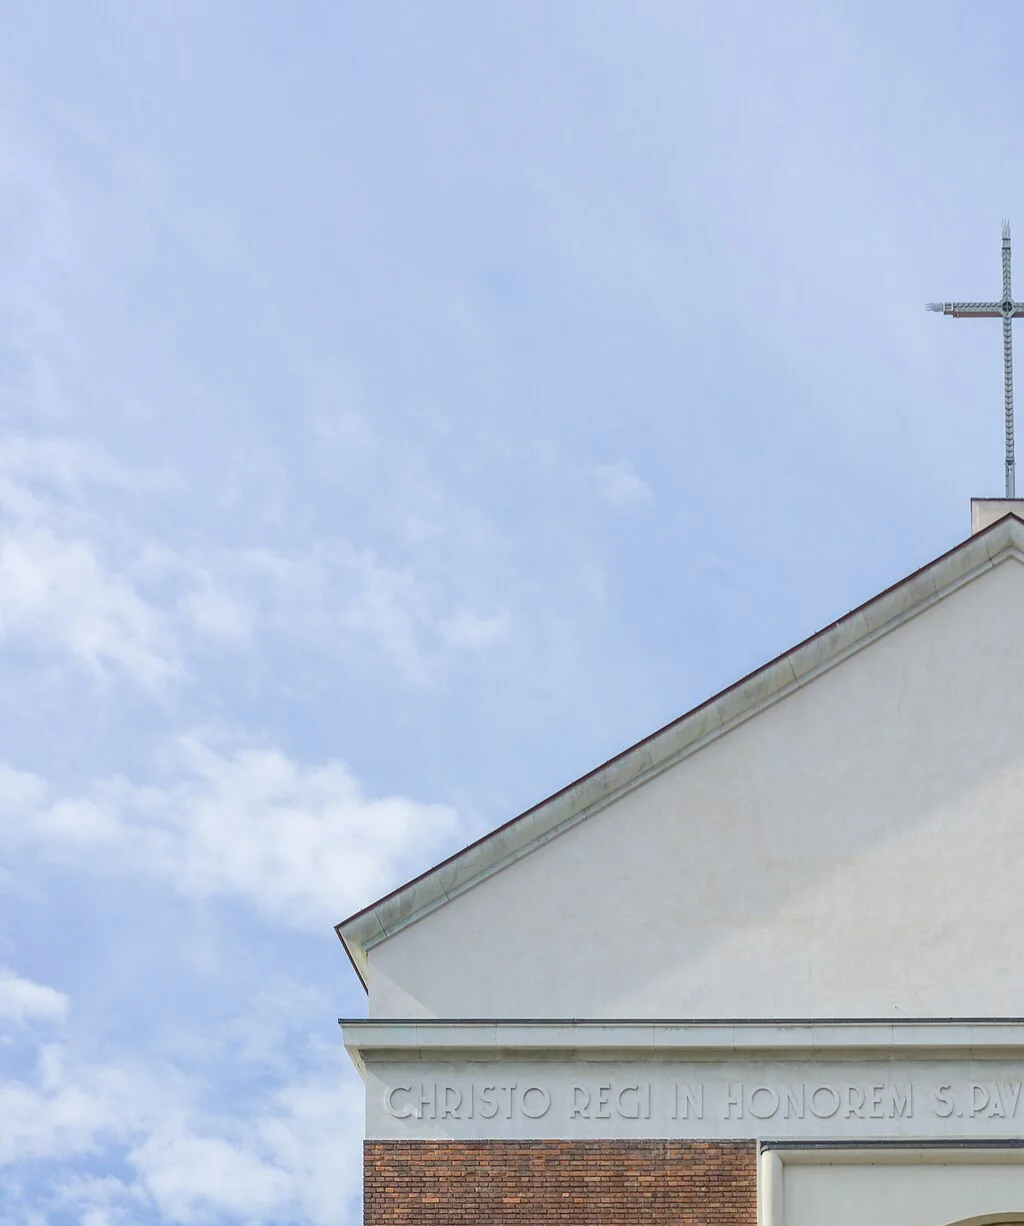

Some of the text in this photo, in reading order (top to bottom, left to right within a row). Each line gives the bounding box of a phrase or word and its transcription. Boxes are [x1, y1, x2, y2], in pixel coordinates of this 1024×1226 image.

[383, 1085, 552, 1120] CHRISTO
[568, 1084, 651, 1120] REGI
[670, 1083, 703, 1120] IN
[722, 1083, 914, 1120] HONOREM
